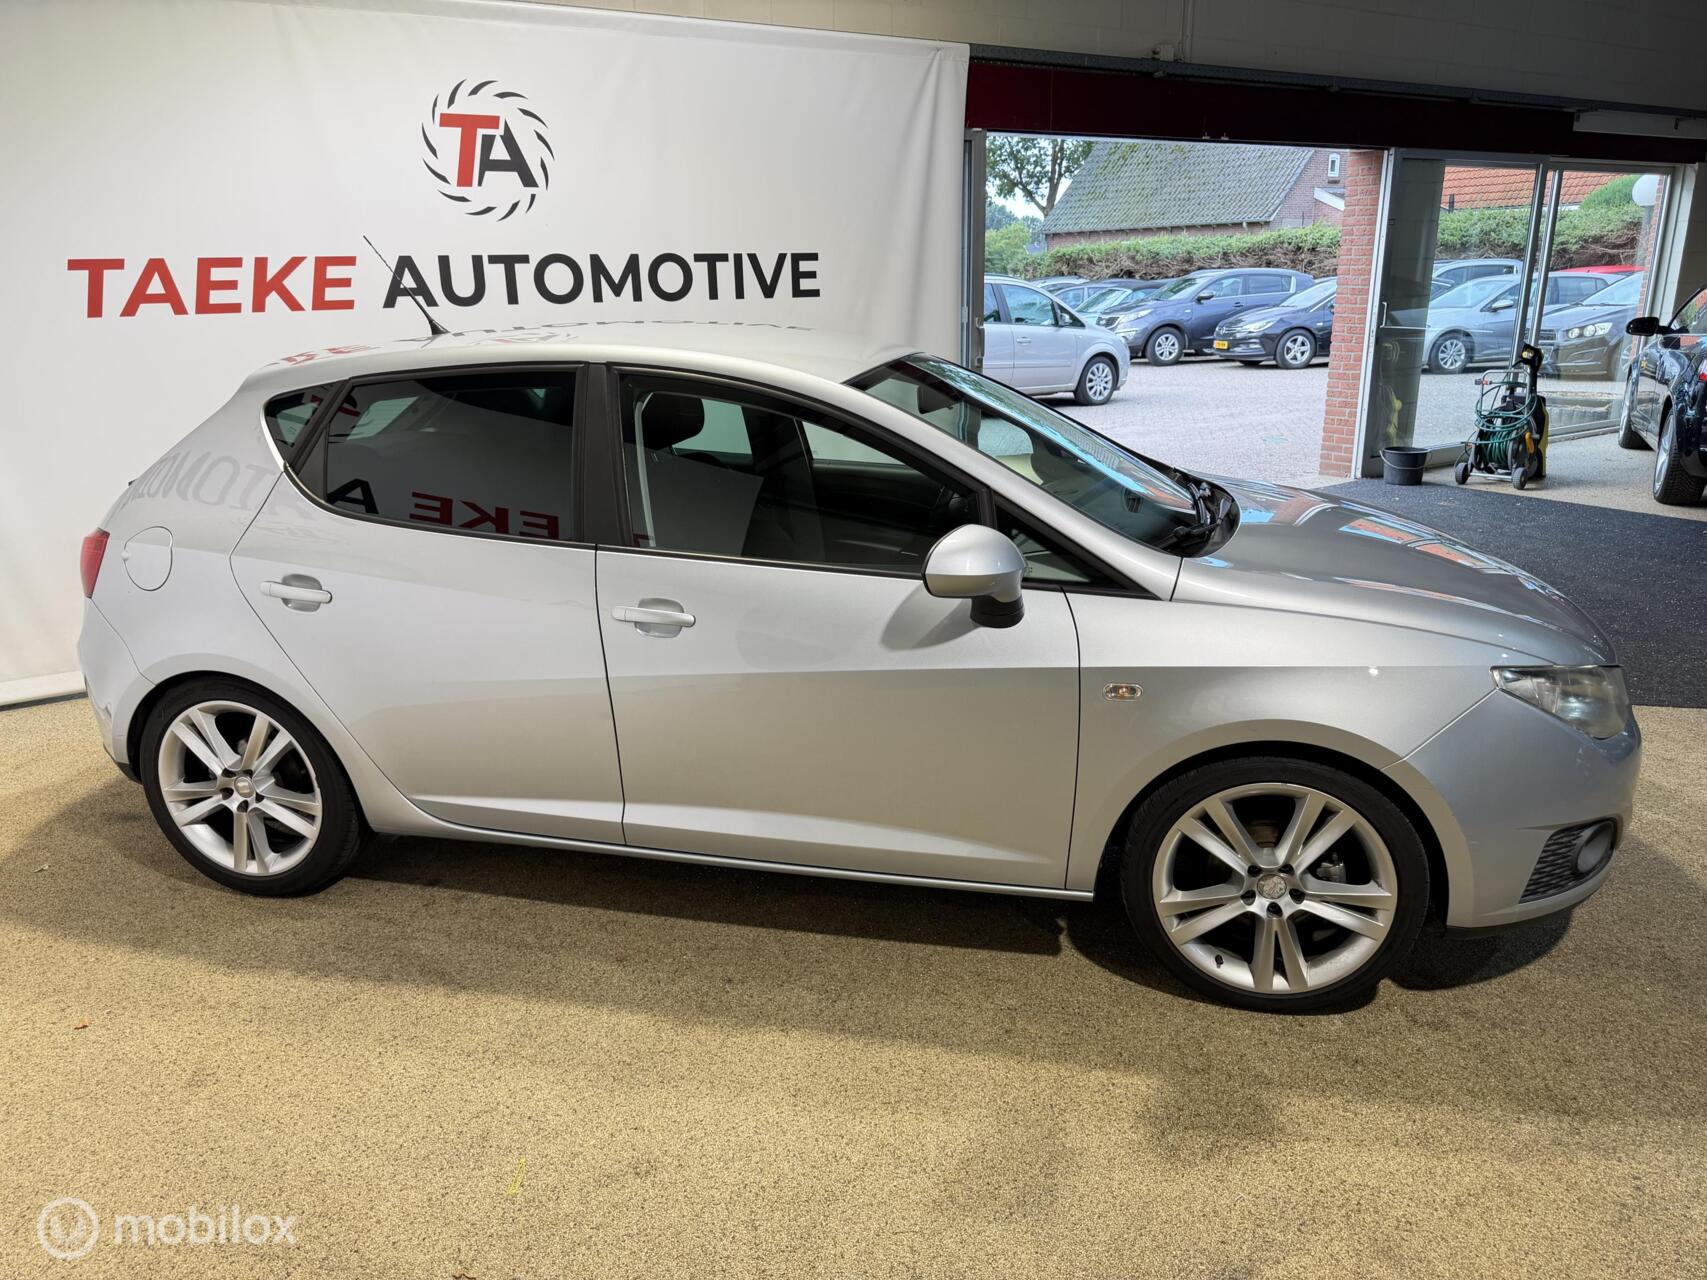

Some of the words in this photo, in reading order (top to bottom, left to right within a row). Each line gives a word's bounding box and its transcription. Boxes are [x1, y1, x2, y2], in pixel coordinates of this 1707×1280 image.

[439, 113, 540, 188] TA
[68, 256, 356, 318] TAEKE
[382, 252, 820, 309] AUTOMOTIVE
